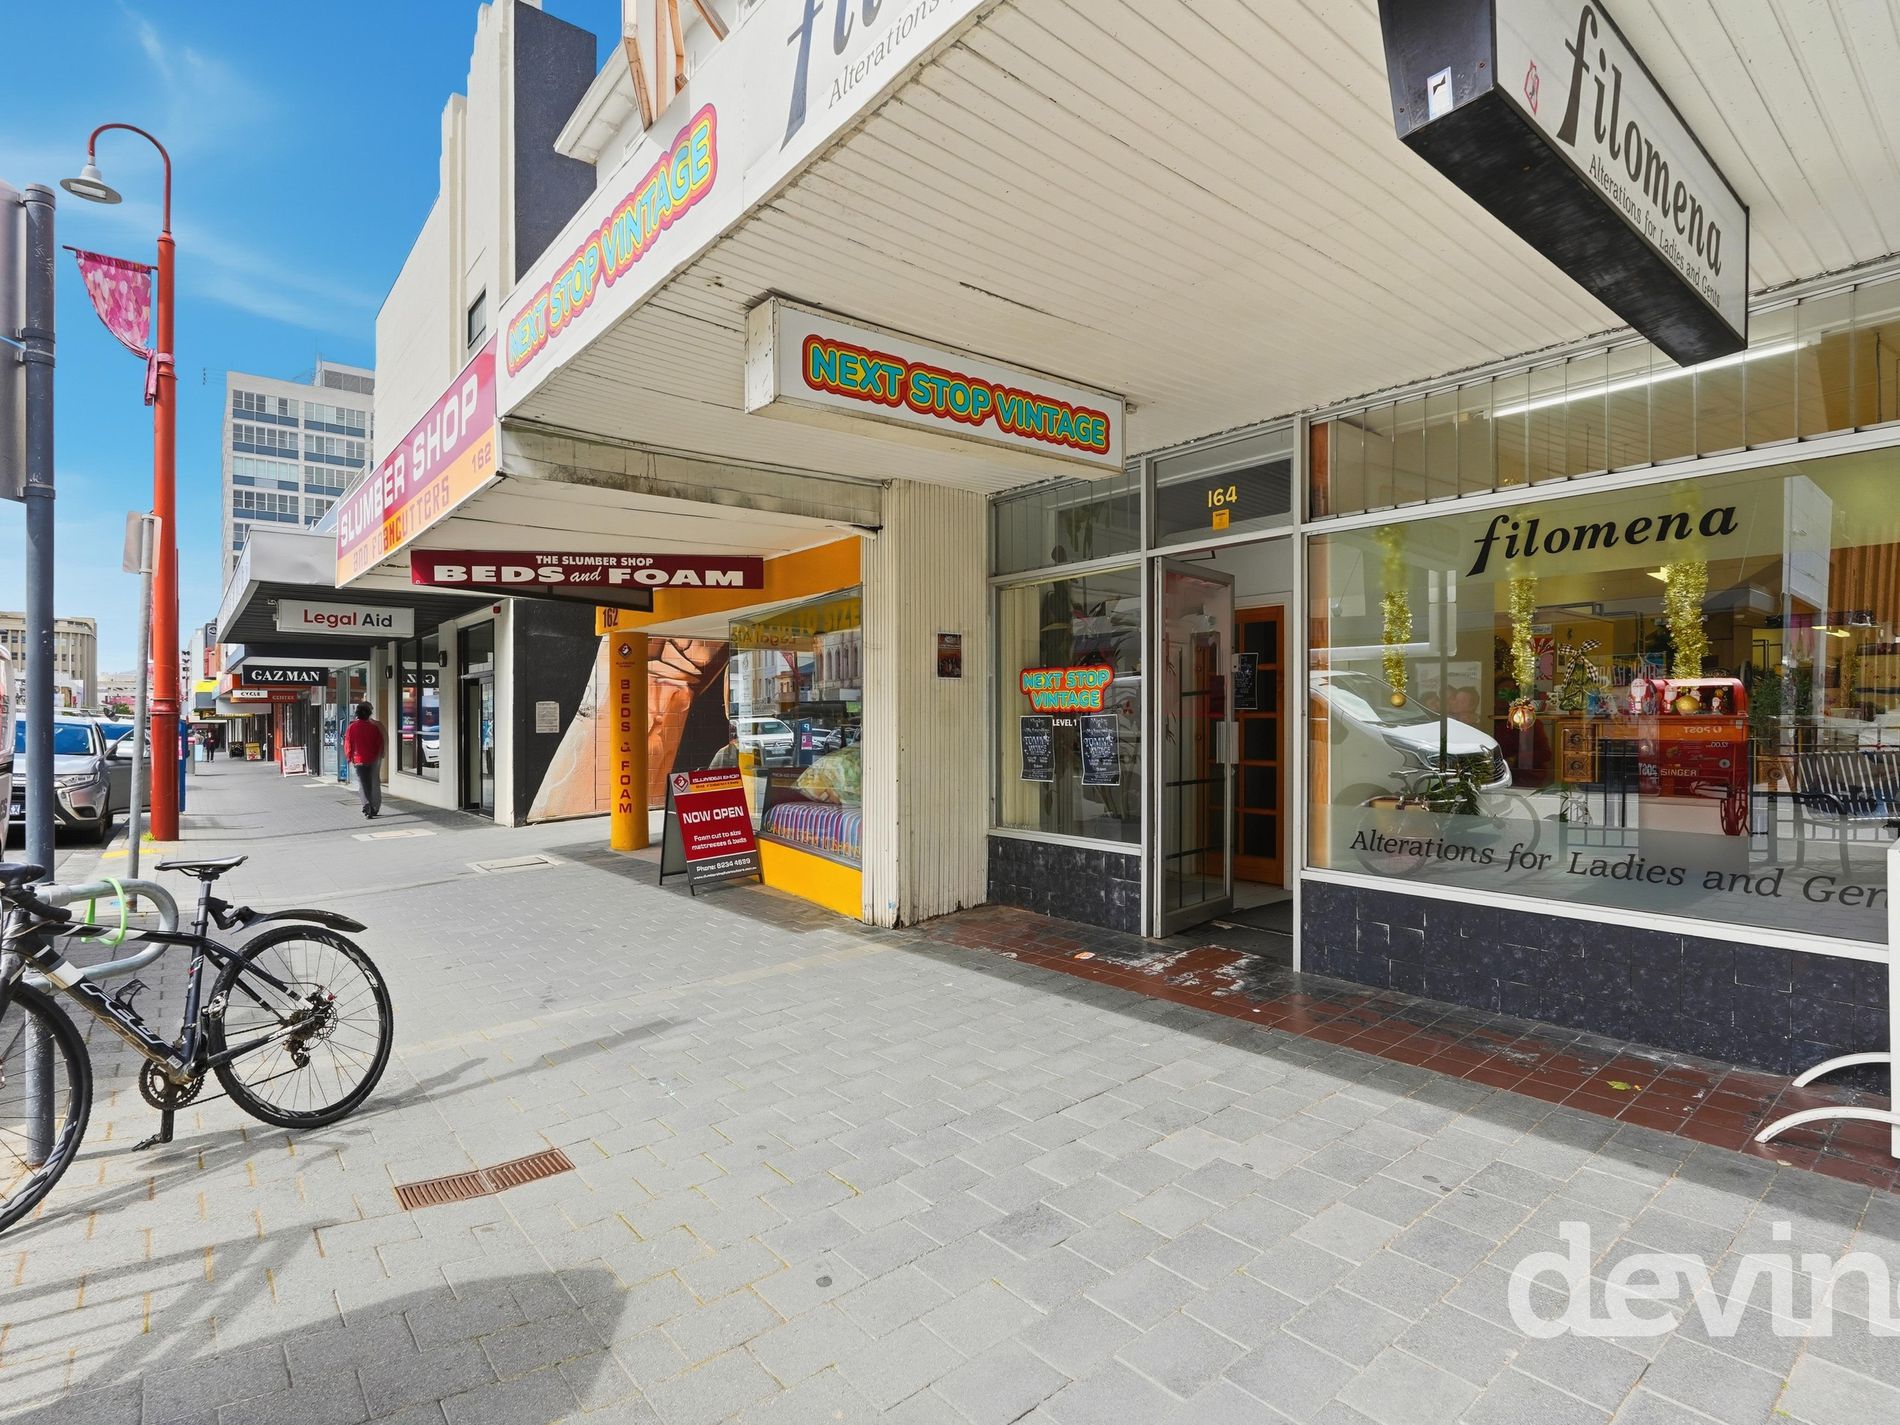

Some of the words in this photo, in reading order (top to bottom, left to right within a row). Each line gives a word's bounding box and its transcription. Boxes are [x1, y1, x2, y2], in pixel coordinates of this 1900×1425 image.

[828, 0, 938, 109] Alterations
[1557, 5, 1722, 277] filomena
[510, 295, 549, 368] NEXT
[550, 246, 599, 328] STOP
[602, 123, 710, 266] VINTAGE
[1589, 154, 1641, 224] Alterations
[1643, 211, 1657, 238] for
[1660, 230, 1684, 270] Ladies
[1686, 263, 1700, 288] and
[1702, 277, 1721, 308] Gents
[812, 345, 903, 397] NEXT
[911, 373, 990, 417] STOP
[997, 393, 1104, 446] VINTAGE
[341, 453, 405, 548] SLUMBER
[412, 374, 478, 482] SHOP
[471, 442, 492, 473] 162
[1208, 485, 1237, 507] 164
[1466, 505, 1738, 578] filomena
[433, 565, 565, 583] BEDS
[570, 565, 601, 583] and
[608, 570, 744, 587] FOAM
[536, 555, 559, 564] THE
[561, 556, 617, 566] SLUMBER
[620, 557, 653, 567] SHOP
[303, 609, 357, 628] Legal
[362, 613, 392, 628] Aid
[602, 608, 618, 628] 162
[1023, 671, 1062, 689] NEXT
[1066, 670, 1109, 688] STOP
[621, 680, 631, 732] BEDS
[1031, 690, 1100, 708] VINTAGE
[1053, 719, 1072, 727] LEVEL
[619, 761, 632, 813] FOAM
[683, 810, 710, 824] NOW
[713, 806, 744, 820] OPEN
[694, 834, 711, 842] Foam
[1351, 831, 1495, 865] Alterations
[1505, 844, 1551, 873] for
[1568, 851, 1685, 886] Ladies
[1704, 867, 1784, 898] and
[1803, 876, 1887, 909] Gen
